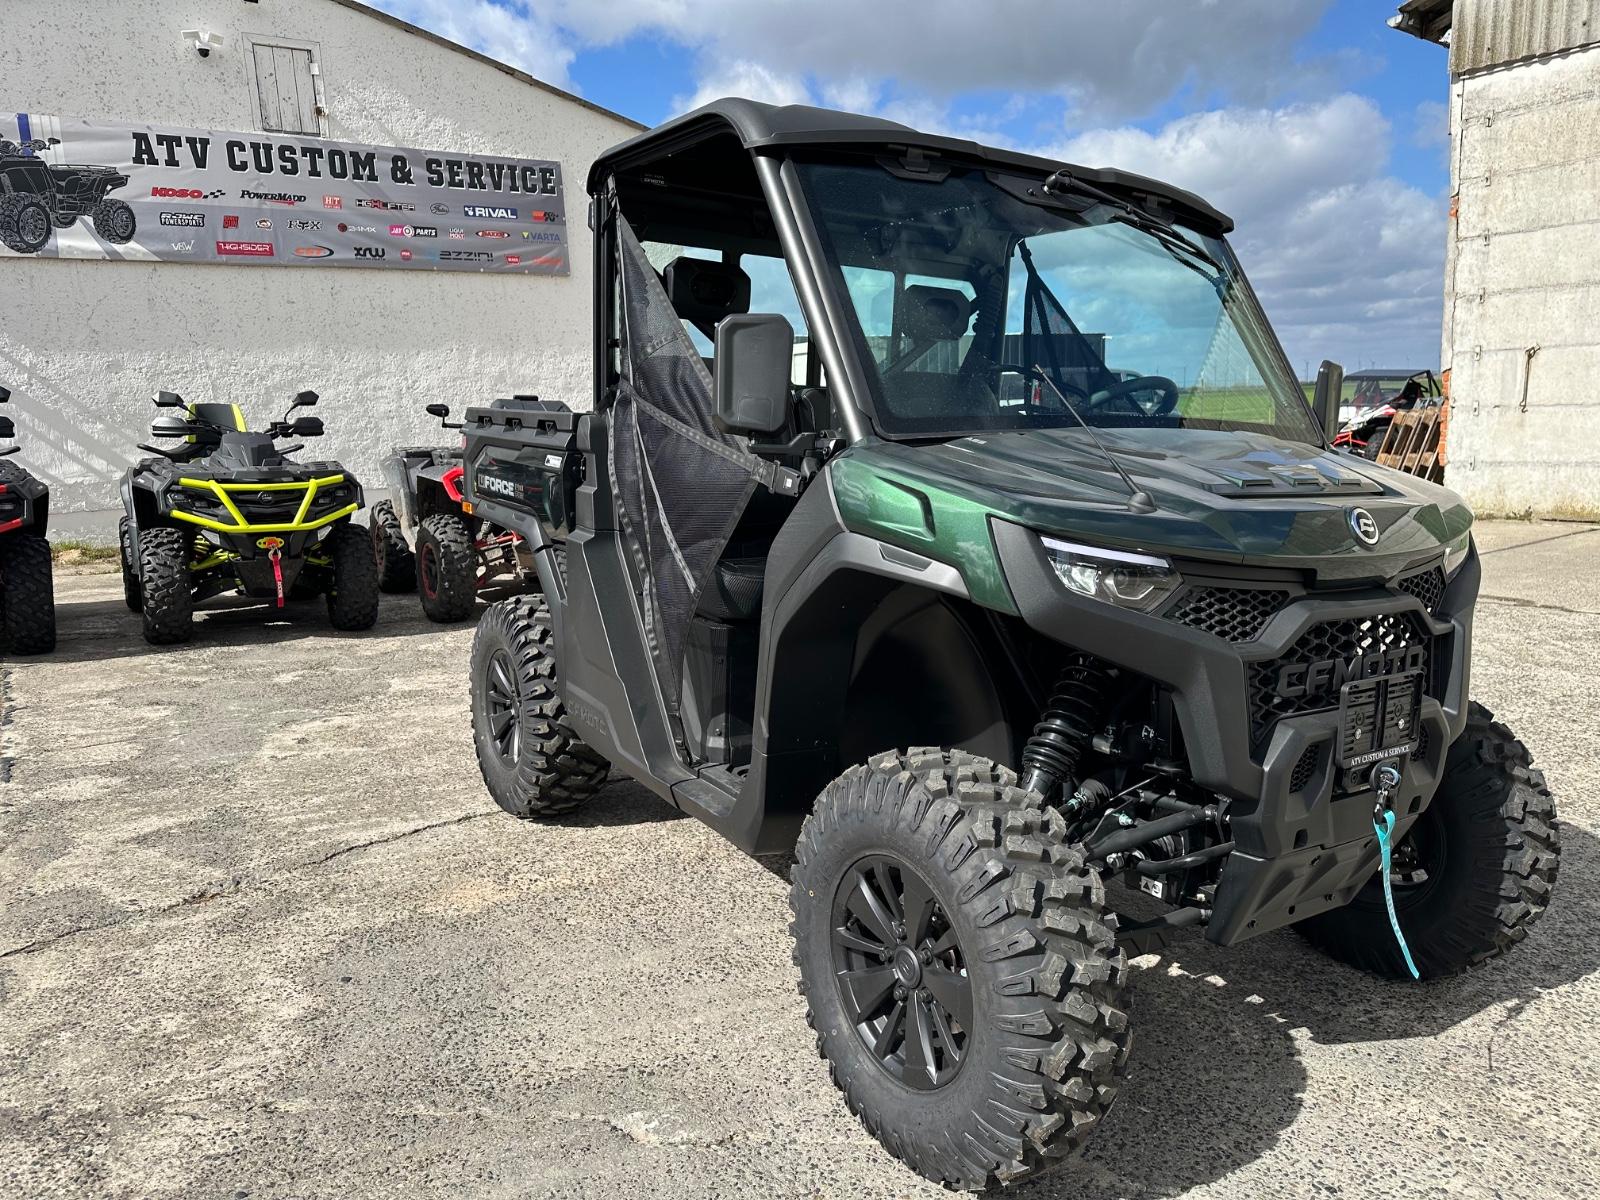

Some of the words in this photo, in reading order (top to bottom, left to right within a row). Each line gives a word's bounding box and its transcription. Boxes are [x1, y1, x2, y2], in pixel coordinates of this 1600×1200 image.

[131, 132, 210, 169] ATV
[225, 140, 379, 182] CUSTOM
[391, 155, 416, 186] &
[426, 158, 557, 196] SERVICE
[151, 187, 203, 199] KOSO
[475, 207, 517, 219] RIVAL
[161, 218, 204, 227] POWERSPORTS
[415, 228, 436, 236] PARTS
[530, 232, 561, 242] VARTA
[1277, 645, 1424, 698] CFMOTO
[1350, 757, 1361, 767] ATV
[1361, 751, 1384, 764] CUSTOM
[1388, 744, 1411, 757] SERVICE
